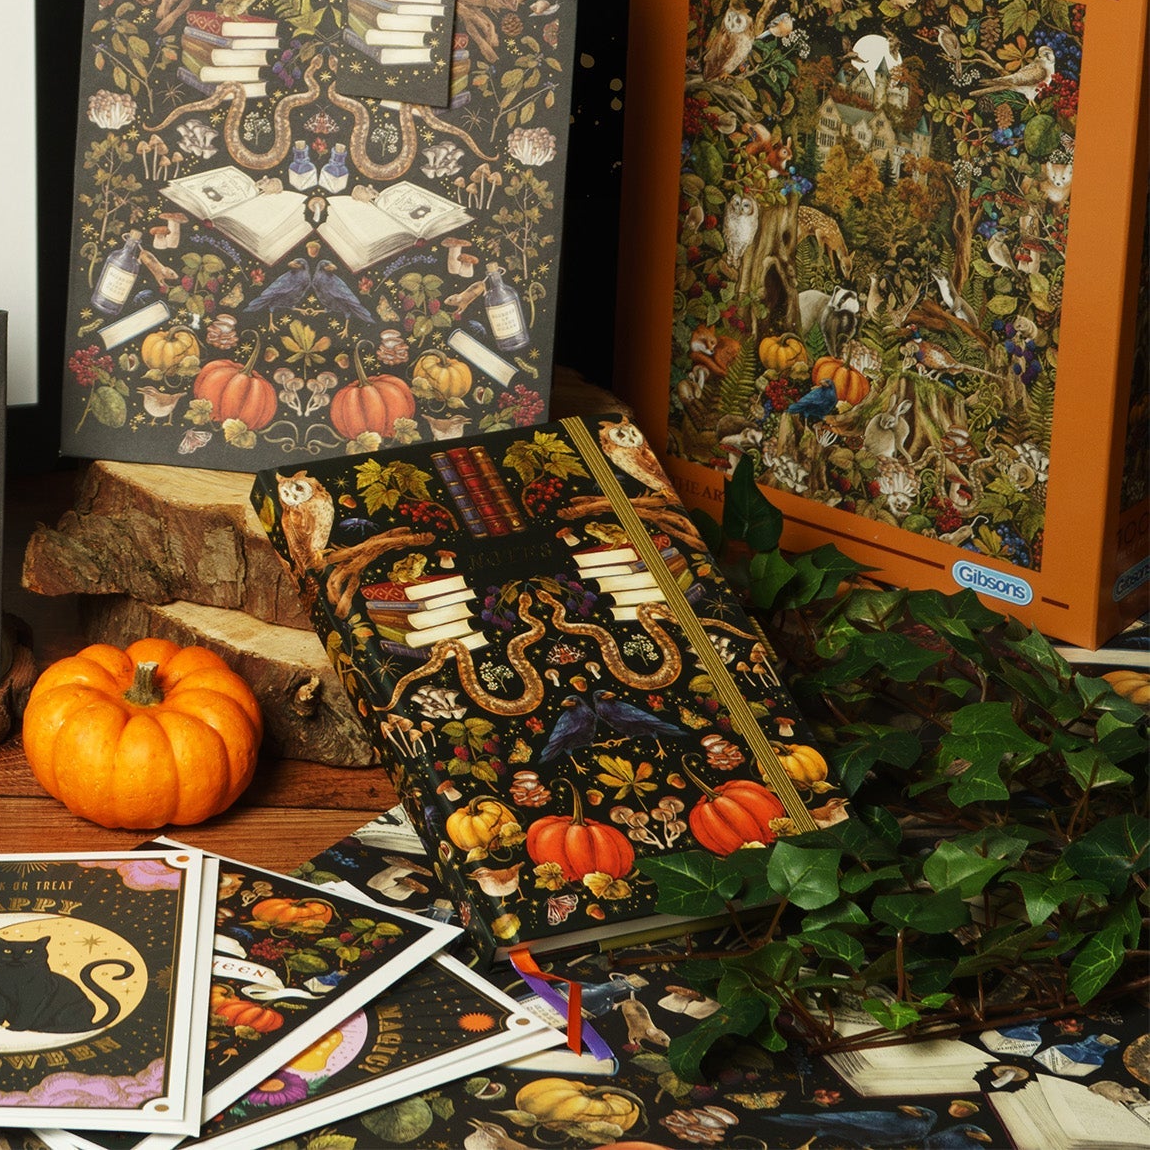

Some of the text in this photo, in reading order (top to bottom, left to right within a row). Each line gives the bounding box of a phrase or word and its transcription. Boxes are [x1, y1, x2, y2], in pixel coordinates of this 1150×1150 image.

[959, 565, 1026, 600] Gibsons
[13, 881, 28, 891] OR
[36, 880, 73, 891] TREAT
